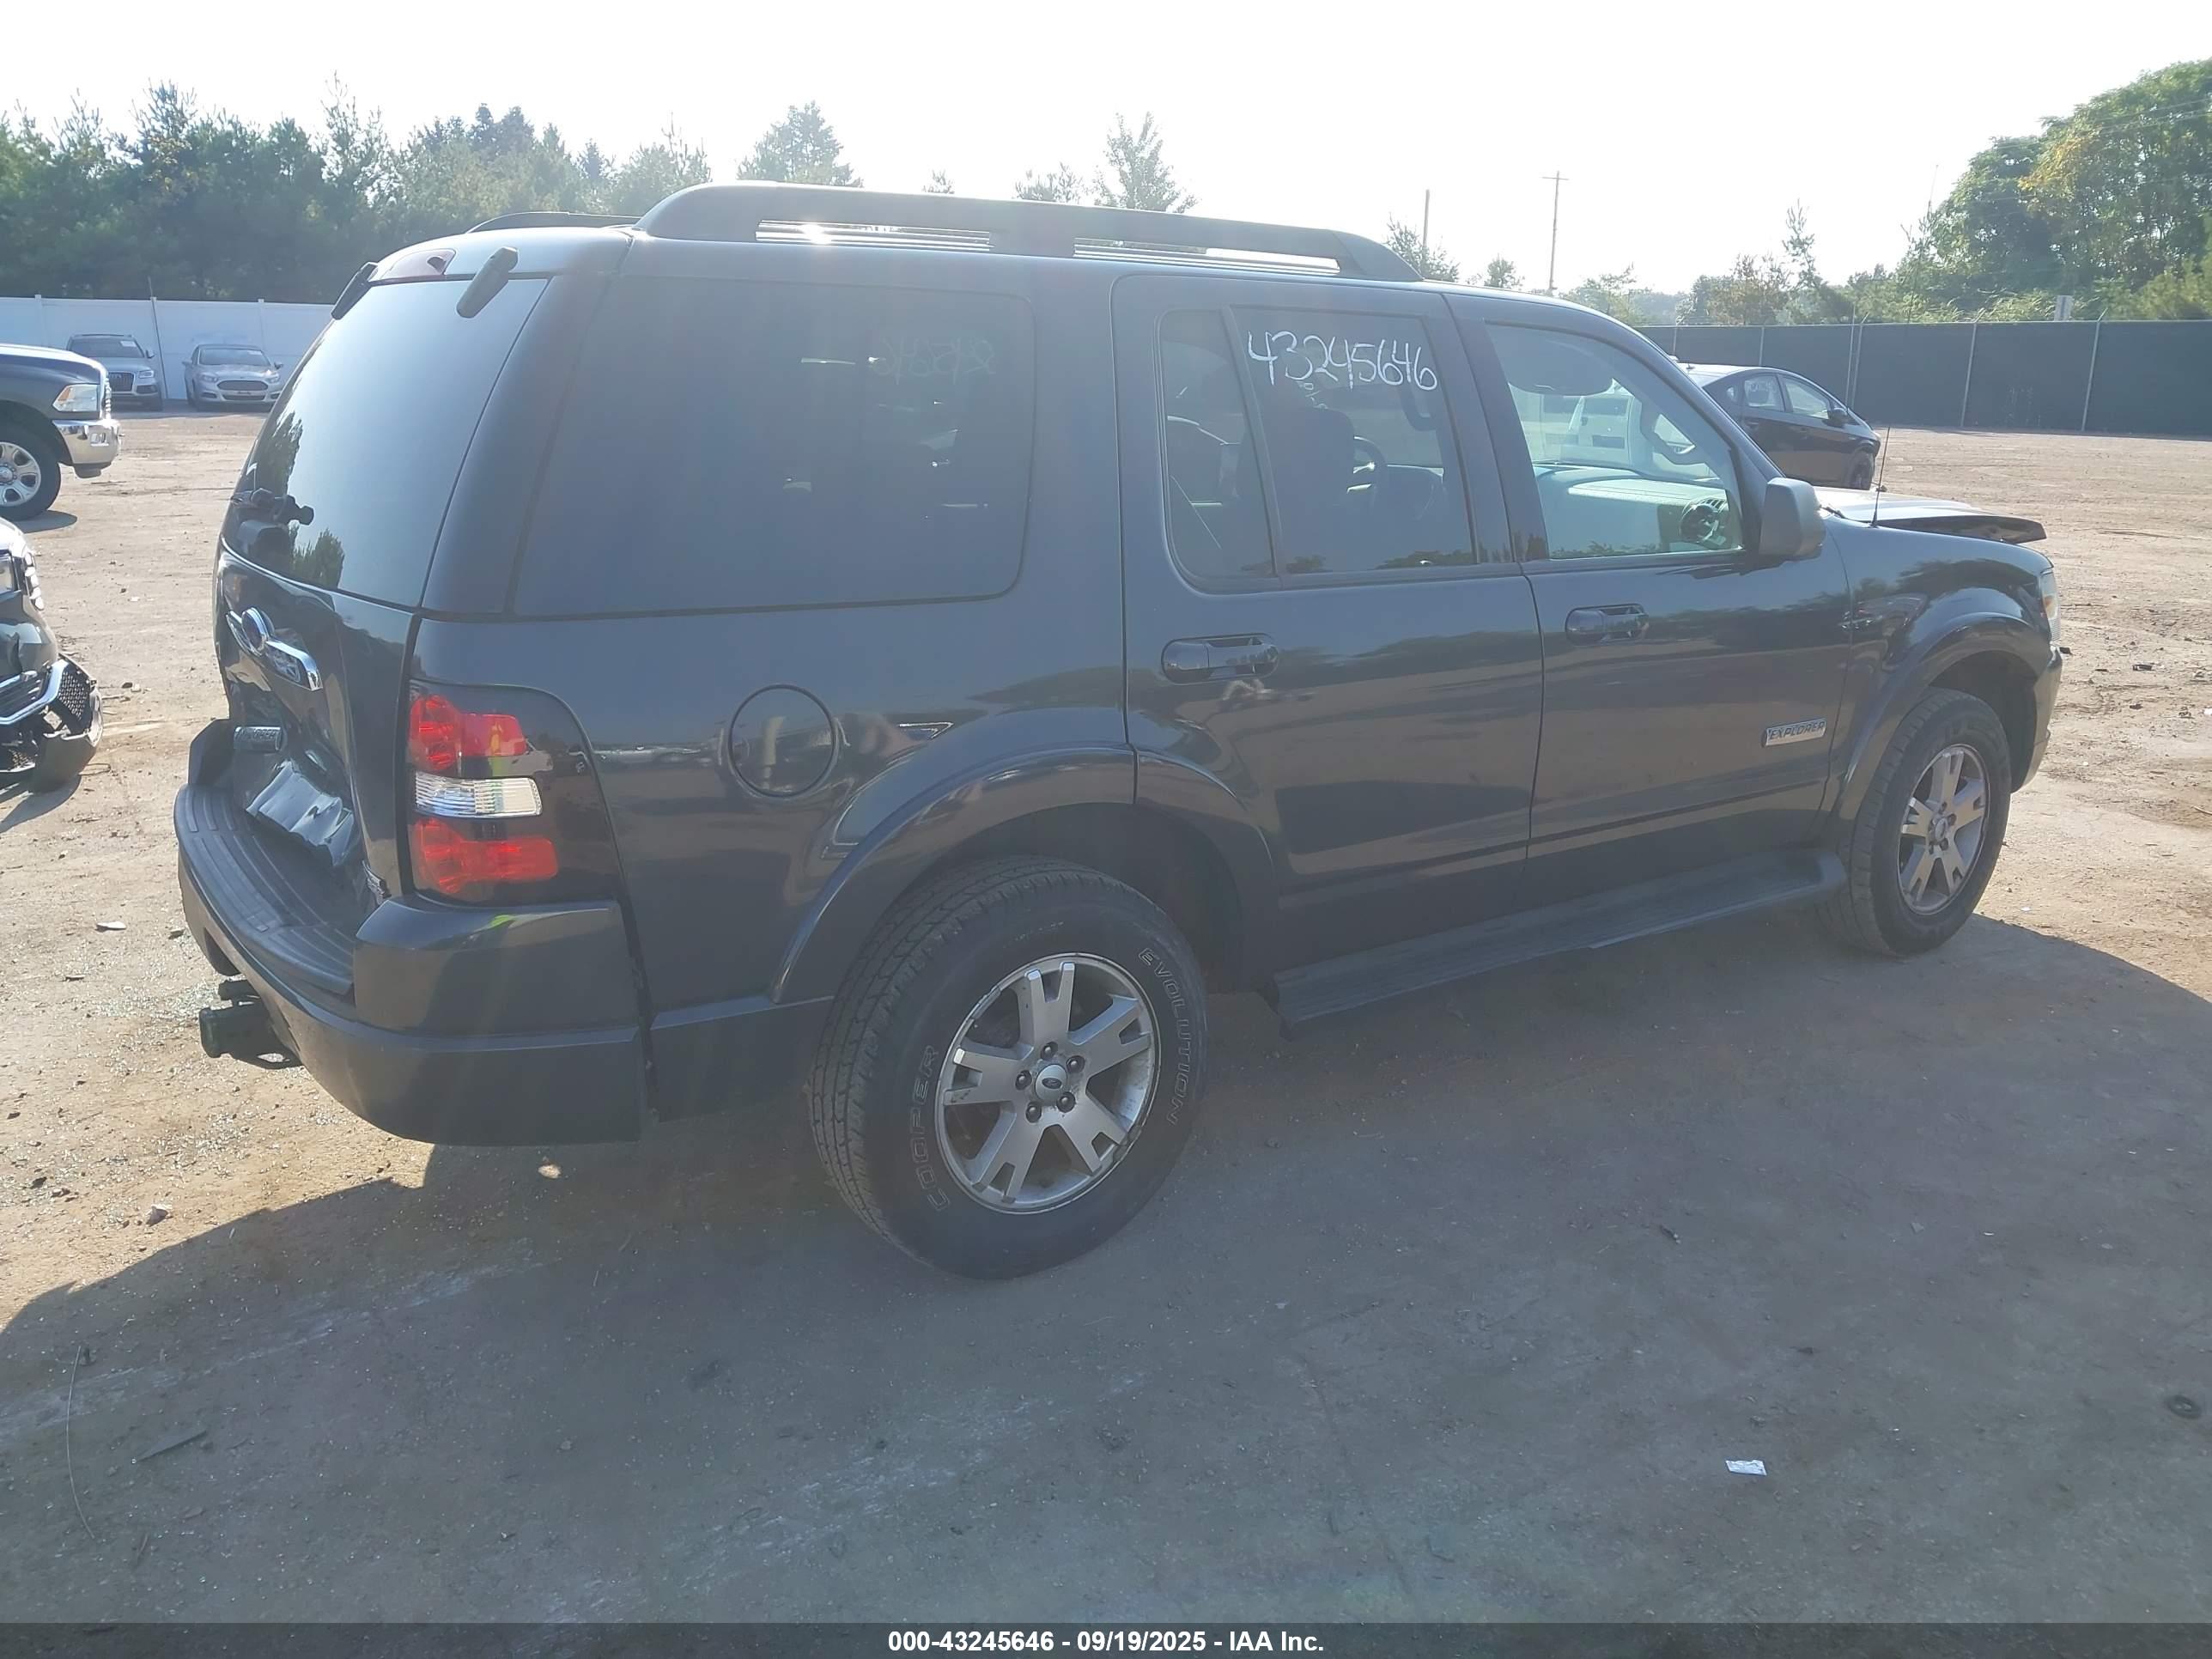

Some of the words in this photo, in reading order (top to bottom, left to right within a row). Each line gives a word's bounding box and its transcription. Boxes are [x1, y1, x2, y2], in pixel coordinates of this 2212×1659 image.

[1247, 330, 1438, 392] 43245646
[1769, 720, 1826, 740] EXPLORER
[1138, 947, 1193, 1126] EVOLUTION
[909, 1044, 951, 1212] COOPER
